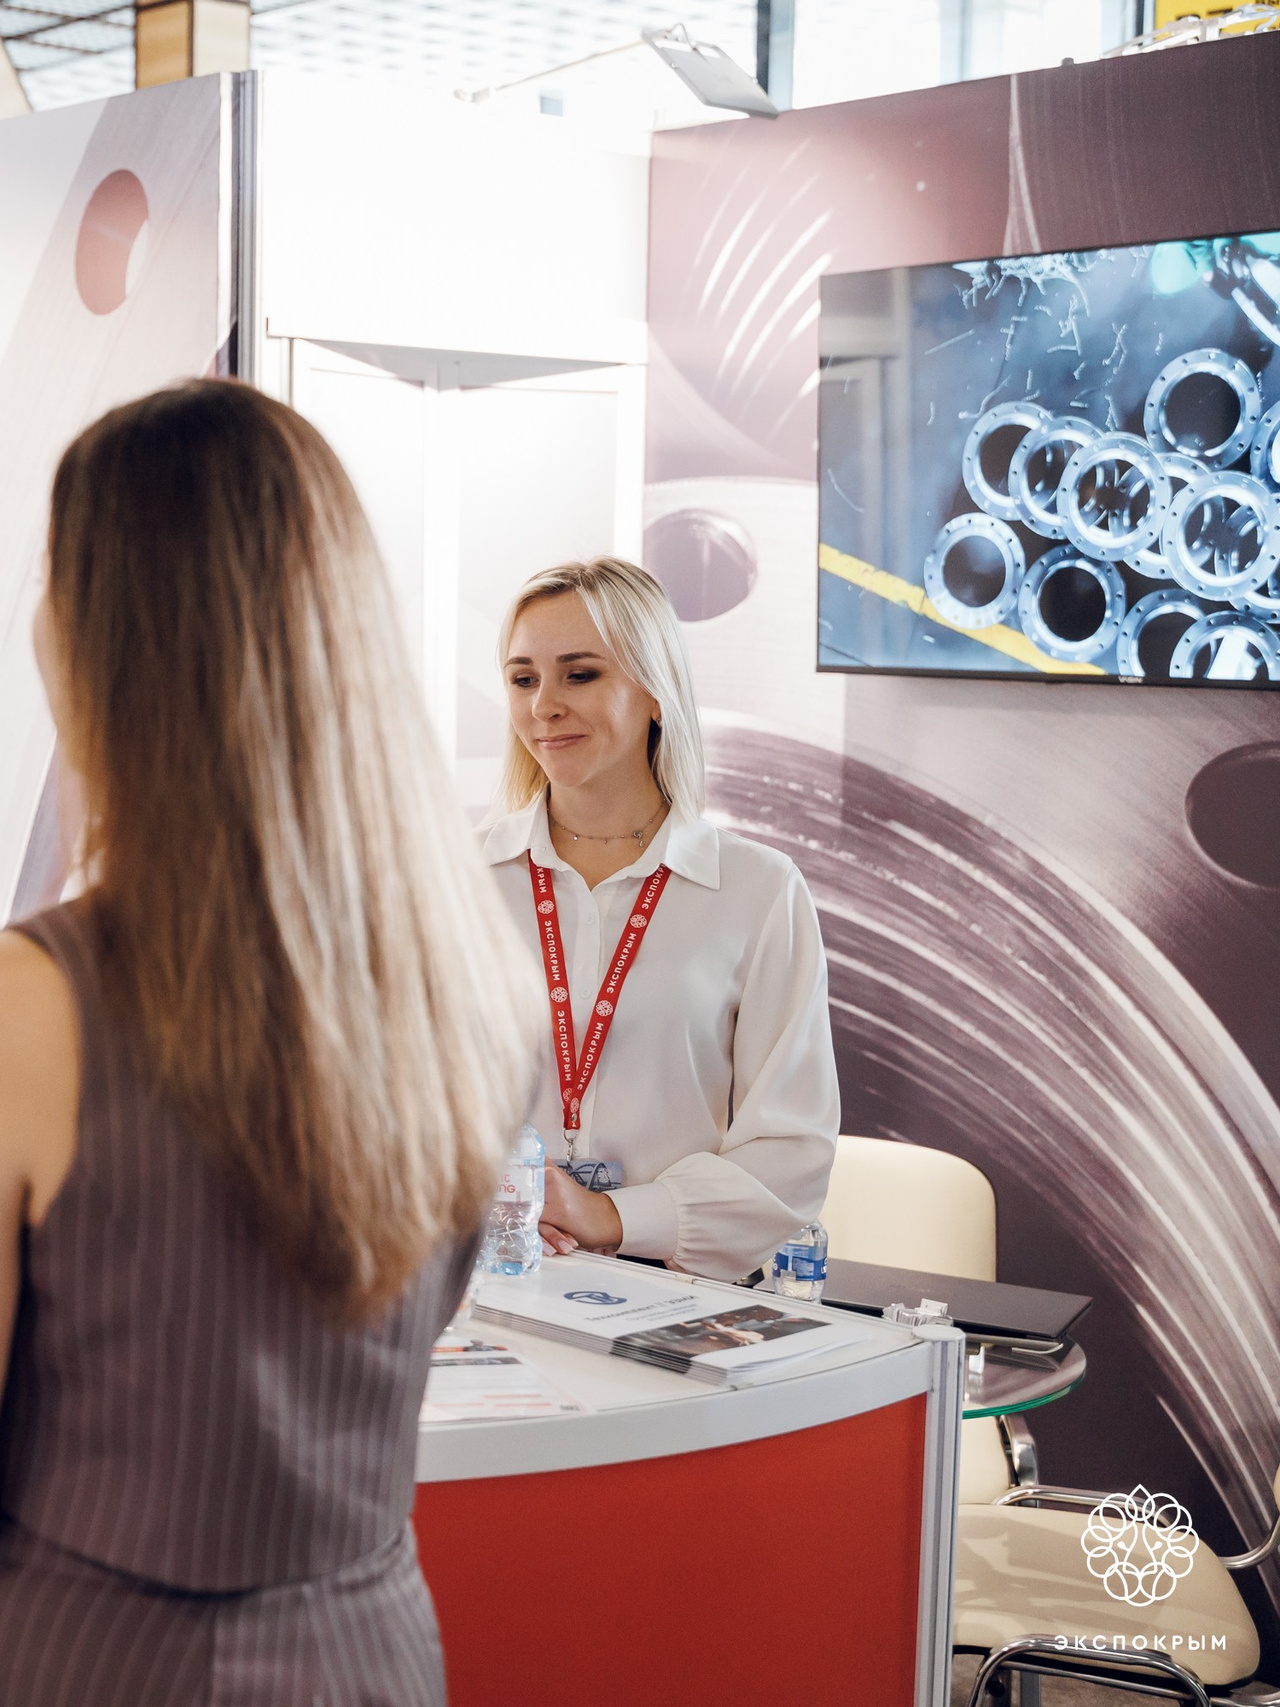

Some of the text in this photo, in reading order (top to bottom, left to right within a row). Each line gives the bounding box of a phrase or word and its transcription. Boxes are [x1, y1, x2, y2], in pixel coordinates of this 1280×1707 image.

[544, 920, 560, 981] ЭКСПОКРЫМ
[606, 933, 637, 993] ЭКСПОКРЫМ
[557, 1010, 571, 1081] ЭКСПОКРЫМ
[577, 1022, 604, 1090] ЭКСПОКРЫМ
